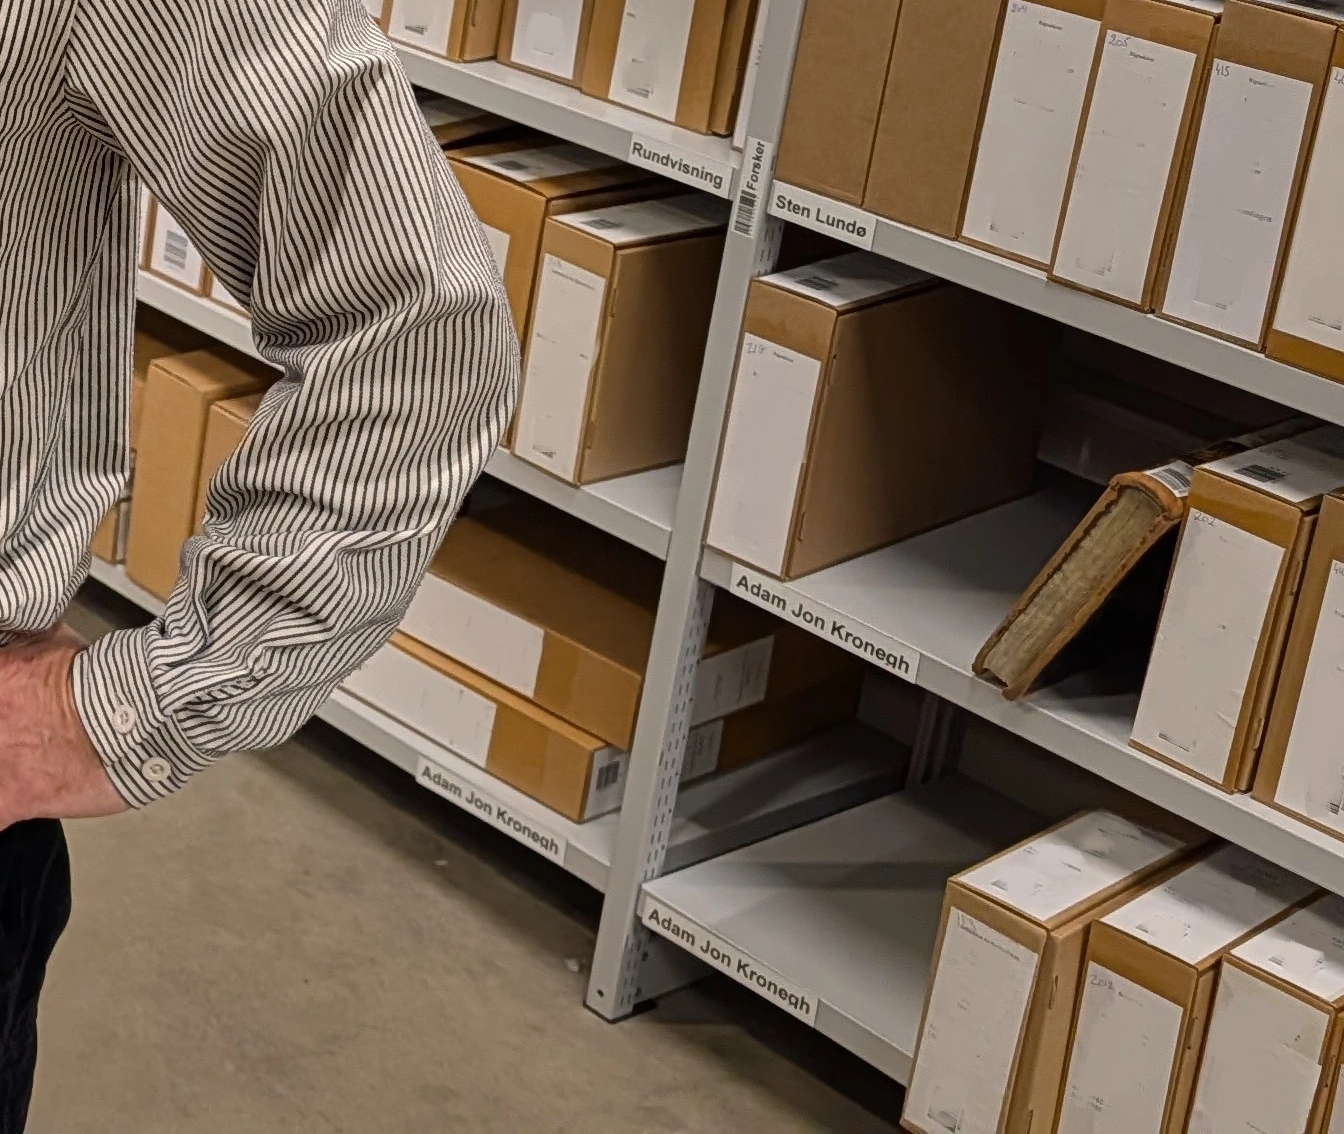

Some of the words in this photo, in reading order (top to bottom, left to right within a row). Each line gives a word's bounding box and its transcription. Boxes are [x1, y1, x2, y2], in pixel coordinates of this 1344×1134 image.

[631, 141, 724, 190] Rundvisning
[746, 141, 766, 191] Forsker
[776, 194, 811, 219] Sten
[815, 208, 867, 237] Lundø
[736, 574, 787, 611] Adam
[791, 603, 826, 631] Jon
[421, 766, 462, 799] Adam
[465, 791, 493, 817] Jon
[648, 909, 696, 947] Adam
[699, 940, 732, 968] Jon
